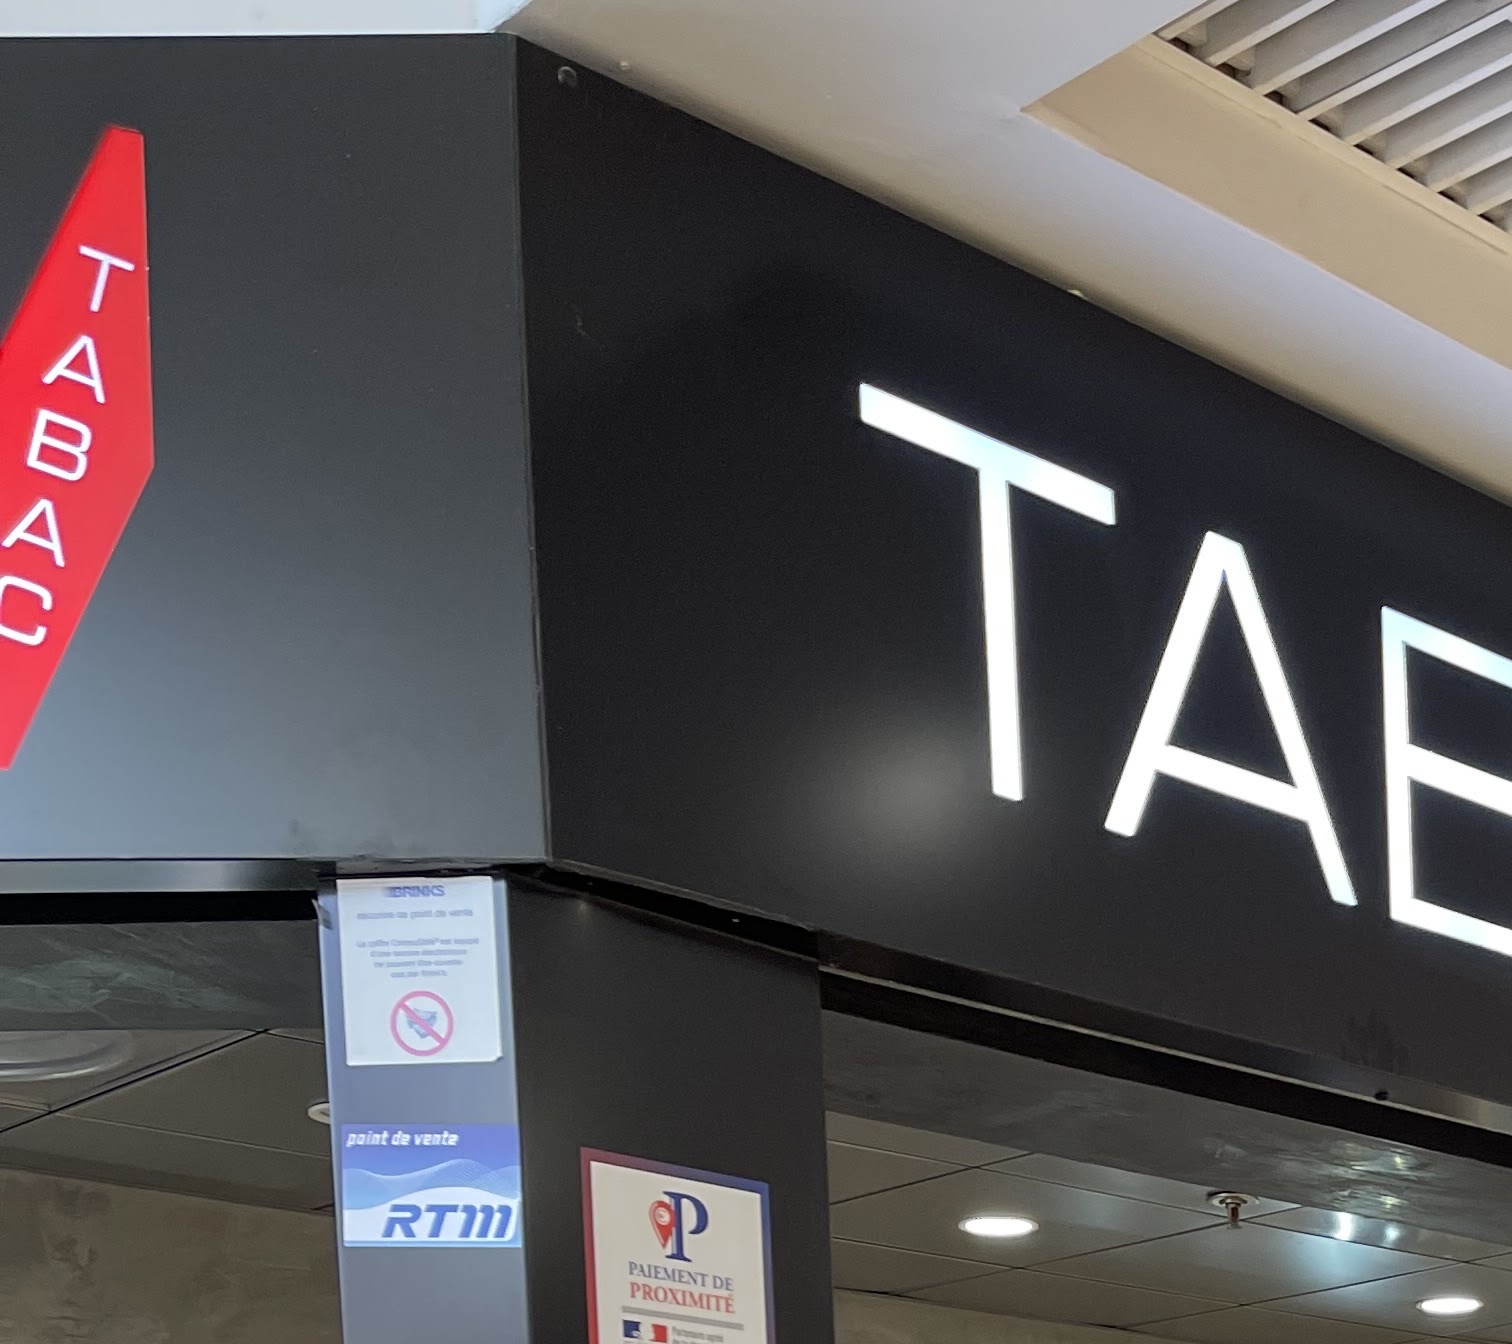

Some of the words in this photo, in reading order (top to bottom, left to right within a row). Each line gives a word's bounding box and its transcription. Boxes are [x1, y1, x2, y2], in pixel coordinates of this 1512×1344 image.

[0, 245, 134, 647] TABAC
[346, 1129, 391, 1149] point
[393, 1130, 410, 1147] de
[414, 1130, 459, 1147] vente
[382, 1203, 513, 1239] RTM
[628, 1261, 708, 1287] PAIEMENT
[712, 1275, 735, 1291] DE
[629, 1281, 735, 1314] PROXIMITÉ
